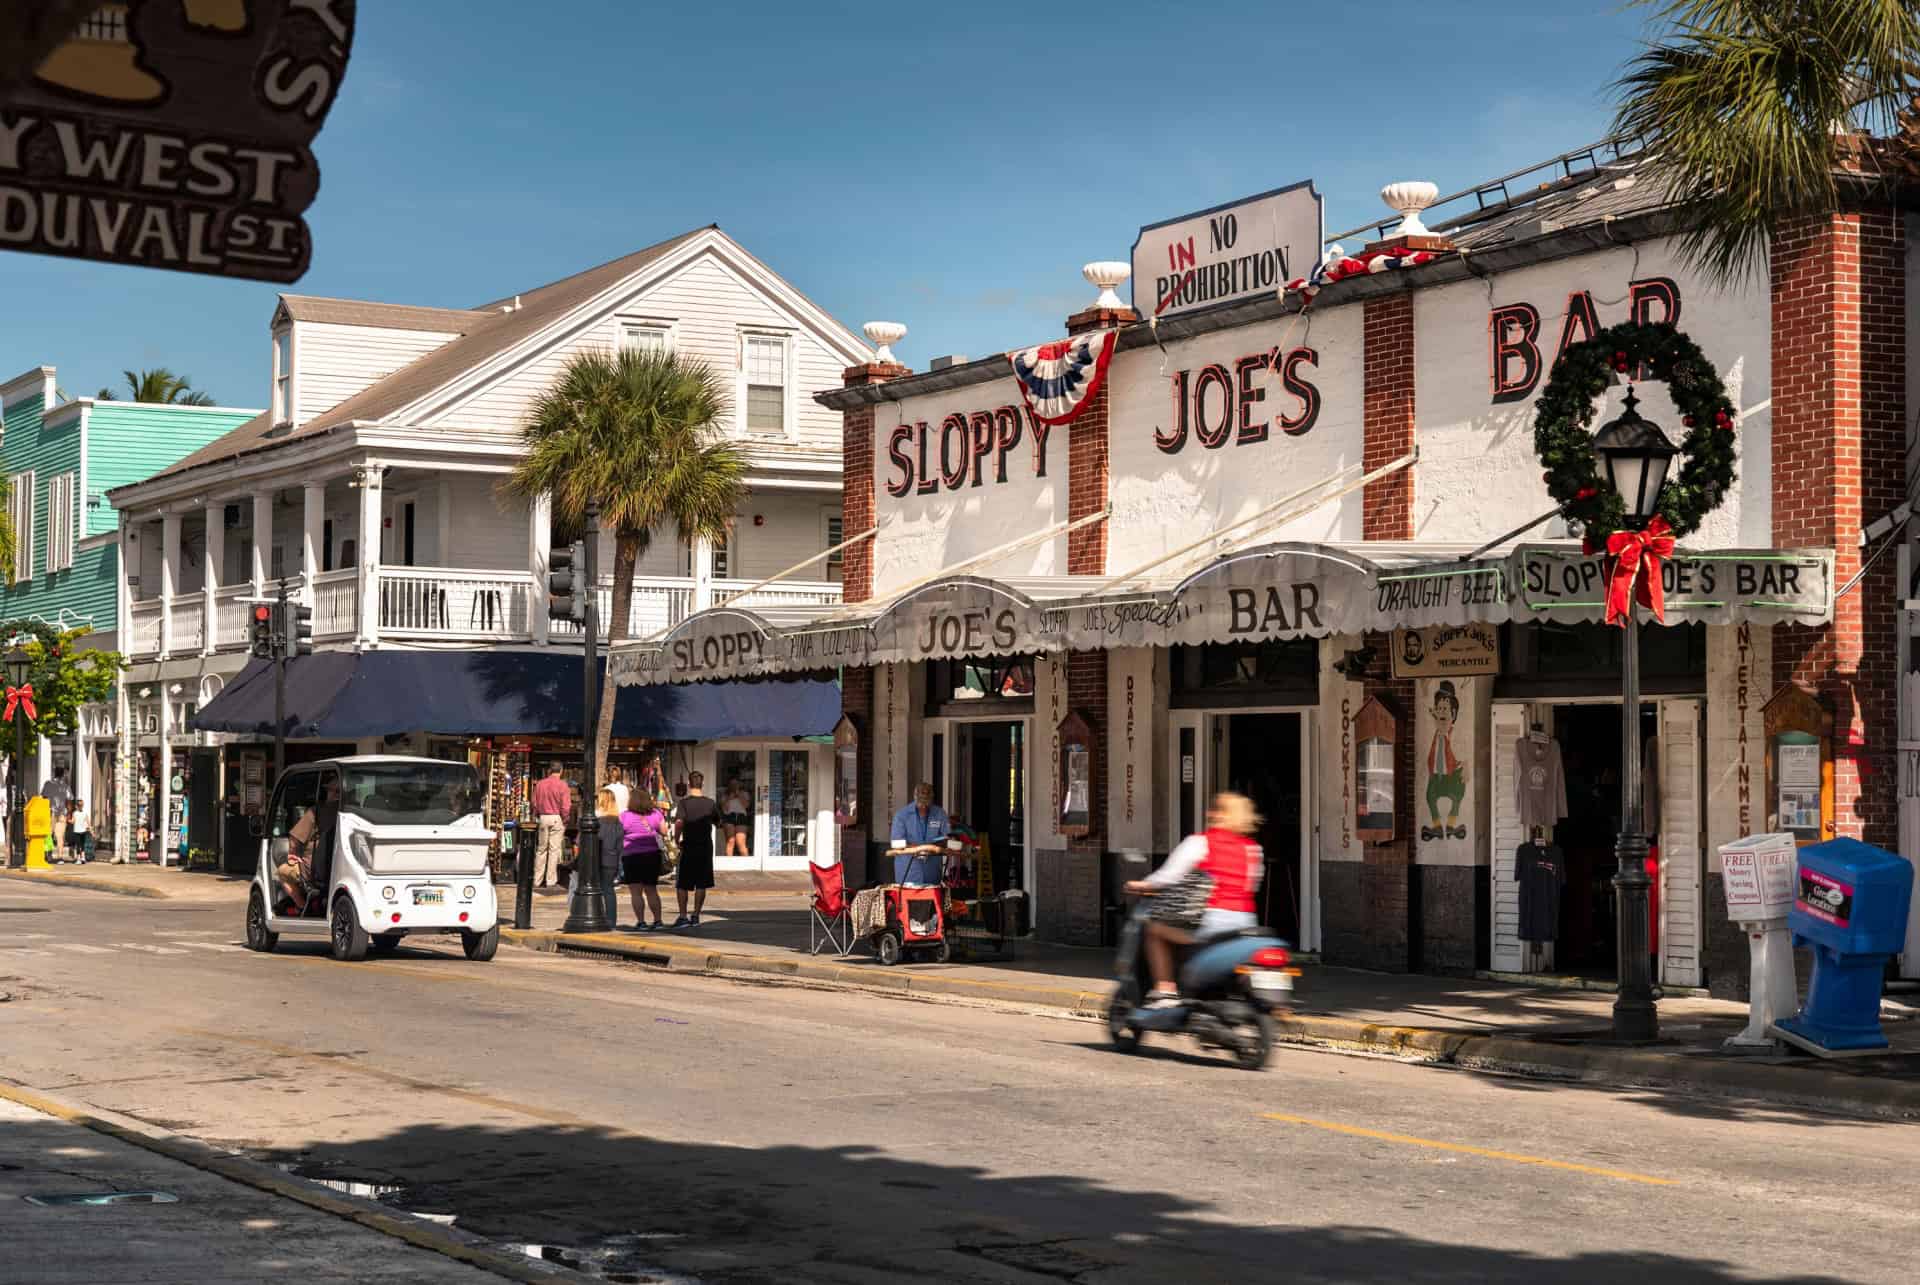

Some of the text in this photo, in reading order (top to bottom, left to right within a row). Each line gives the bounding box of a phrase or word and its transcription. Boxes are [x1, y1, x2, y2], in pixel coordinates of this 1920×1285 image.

[54, 121, 295, 204] WEST
[0, 186, 222, 265] DUVAL
[1168, 236, 1196, 271] IN
[1209, 213, 1238, 254] NO
[1156, 245, 1290, 310] PROHIBITION
[1152, 345, 1321, 455] JOE'S
[884, 403, 1051, 498] SLOPPY
[1377, 577, 1453, 613] DRAUGHT
[1527, 559, 1802, 598] SLOP OE'S BAR
[919, 607, 1017, 653] JOE'S
[1039, 609, 1071, 633] SLOPPY
[1228, 582, 1323, 634] BAR
[673, 630, 766, 673] SLOPPY
[1051, 662, 1059, 722] PINA
[1126, 676, 1134, 824] DRAFT BEER
[1737, 624, 1750, 838] NTERTAINMEN
[1341, 700, 1350, 849] COCKTAILS
[1725, 855, 1753, 866] FREE
